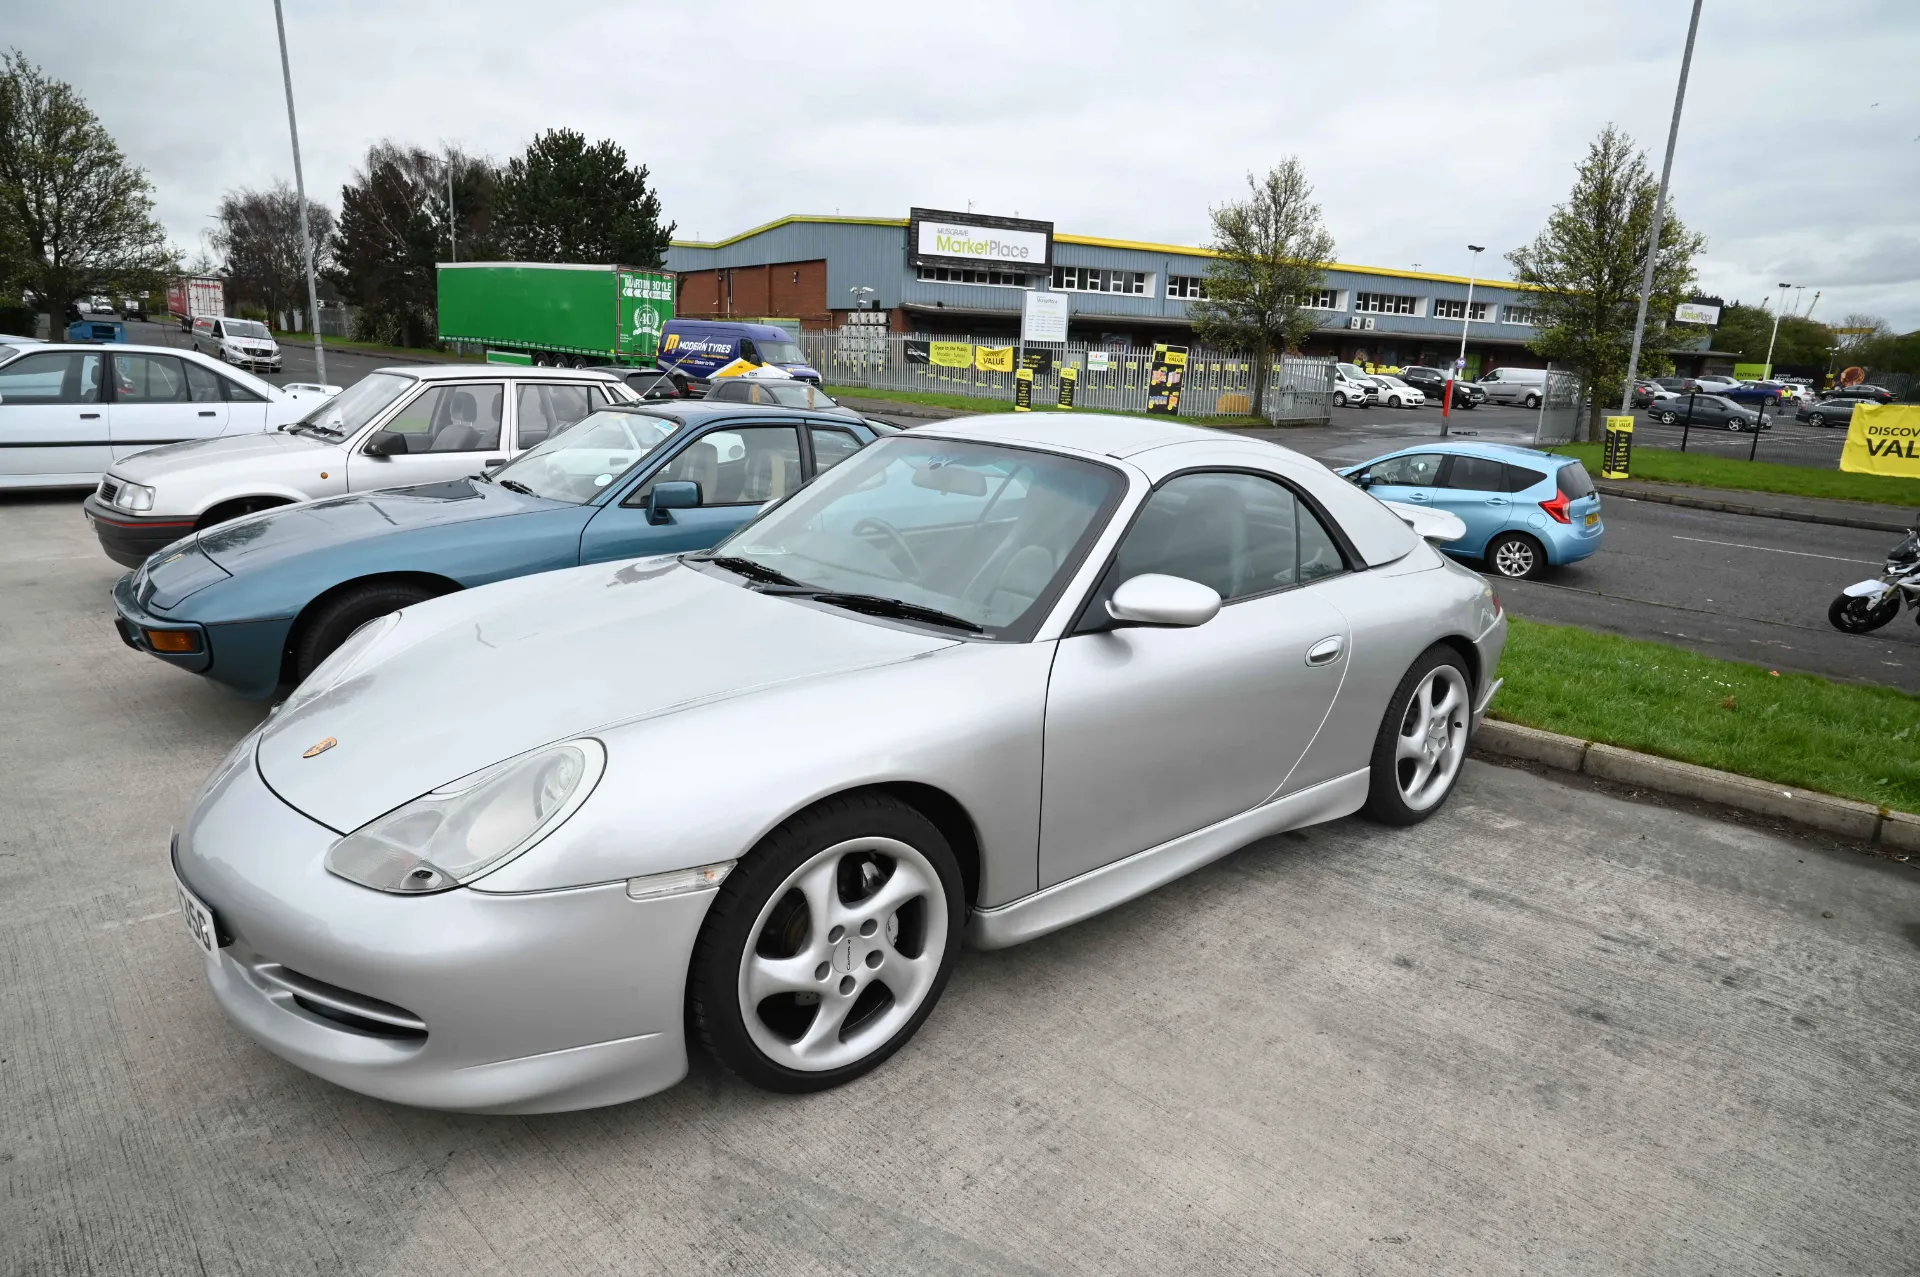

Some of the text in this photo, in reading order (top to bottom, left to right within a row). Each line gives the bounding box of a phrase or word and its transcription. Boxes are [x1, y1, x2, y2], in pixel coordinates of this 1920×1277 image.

[937, 228, 969, 237] MUSGRAVE
[936, 235, 1029, 258] MarketPlace
[625, 278, 672, 292] MARTIN BOYLE
[640, 314, 653, 324] 40
[679, 341, 731, 354] MODERN TYRES
[983, 357, 1005, 366] VALUE
[1774, 376, 1814, 384] MarketPlace
